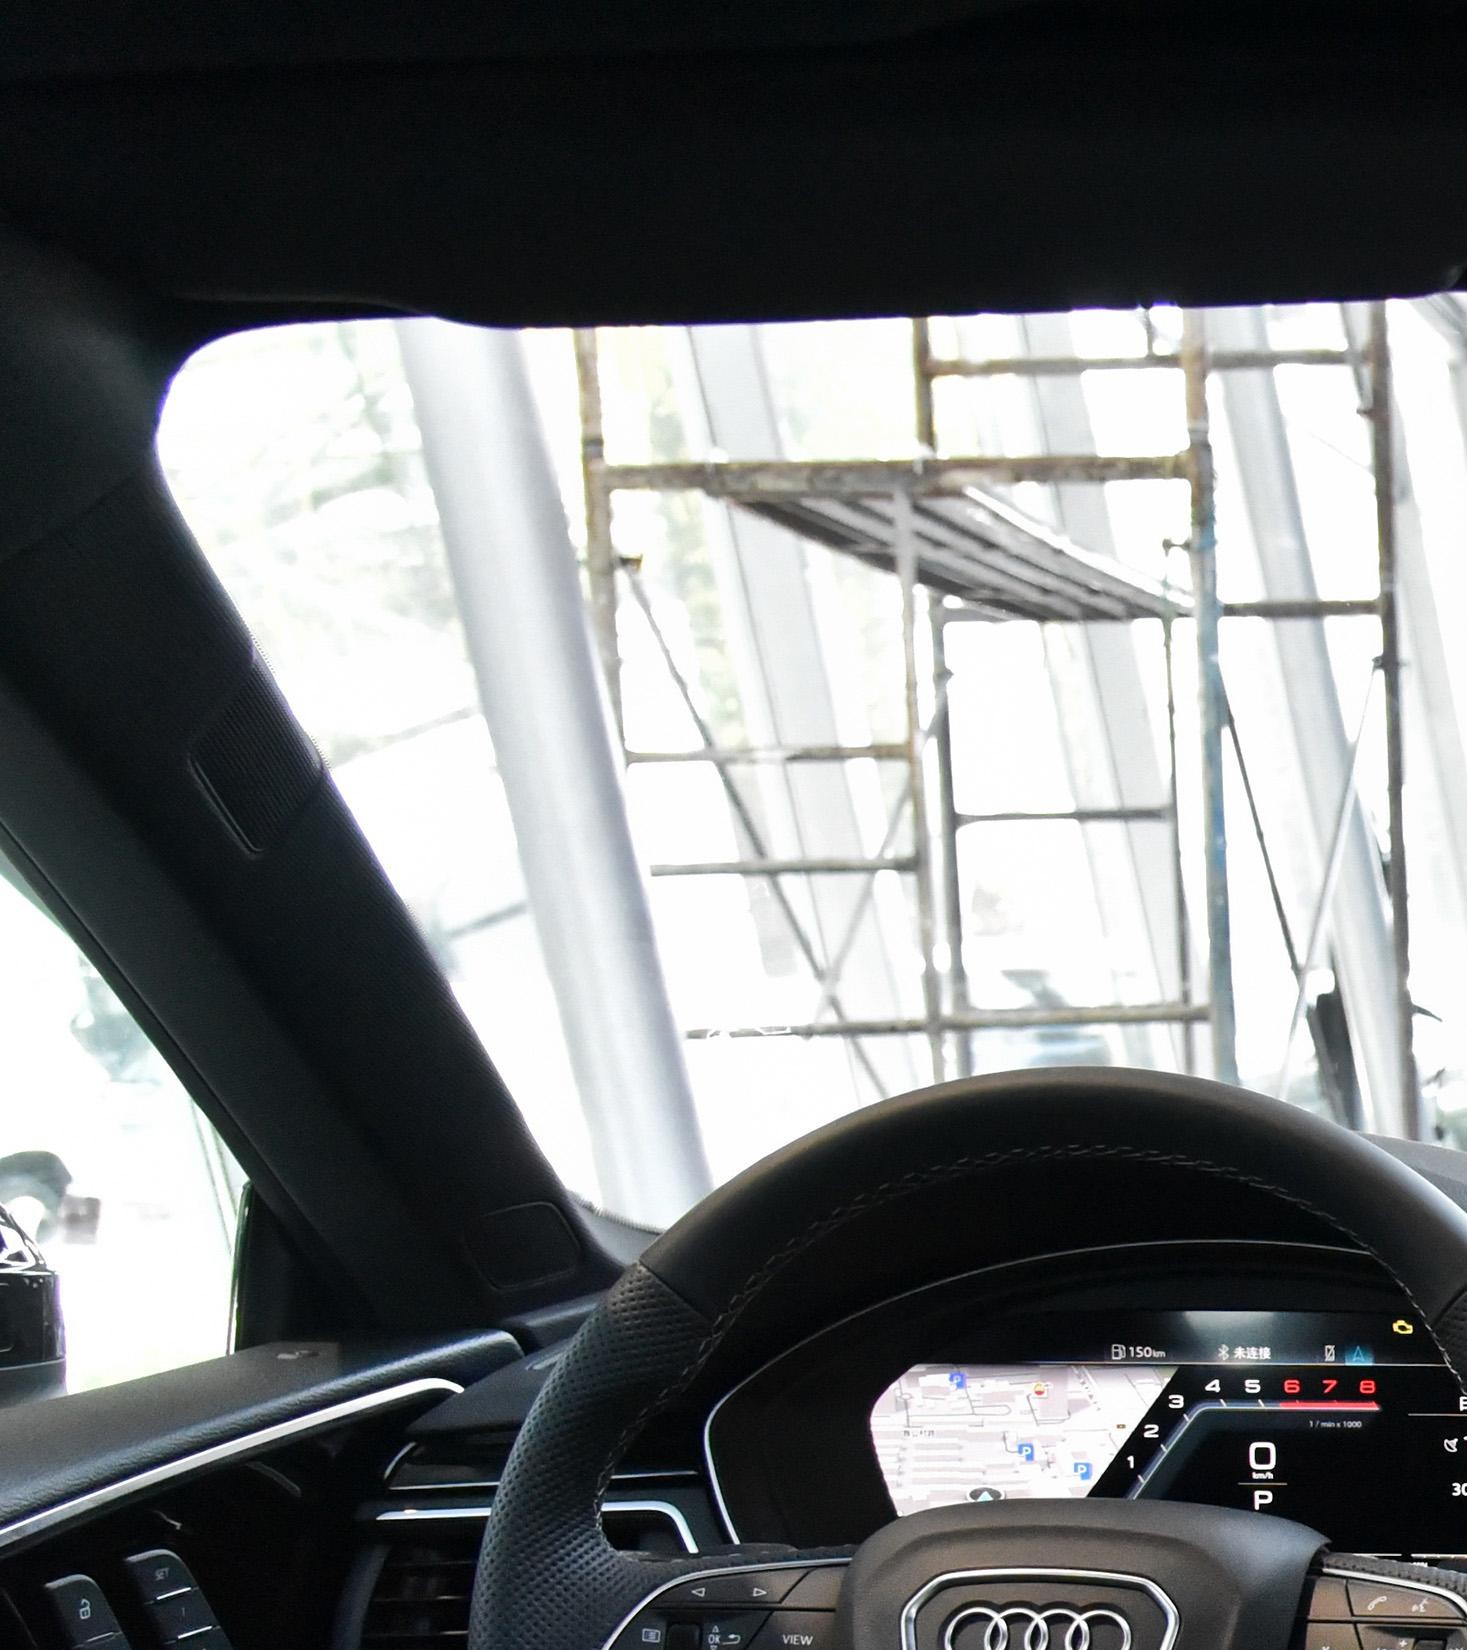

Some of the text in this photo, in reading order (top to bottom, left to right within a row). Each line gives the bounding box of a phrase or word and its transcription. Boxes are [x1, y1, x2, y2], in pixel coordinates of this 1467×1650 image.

[1233, 1346, 1272, 1360] 未连接
[1204, 1379, 1221, 1394] 4
[1244, 1379, 1262, 1394] 5
[1283, 1379, 1301, 1394] 6
[1322, 1379, 1340, 1394] 7
[1359, 1379, 1377, 1394] 8
[1168, 1394, 1185, 1409] 3
[1143, 1424, 1160, 1438] 2
[1343, 1420, 1363, 1429] 1000
[1126, 1455, 1135, 1469] 1
[1248, 1441, 1277, 1471] 0
[1251, 1471, 1274, 1480] km/h
[1253, 1490, 1273, 1511] P
[707, 1633, 722, 1645] OK
[782, 1634, 815, 1647] VIEW
